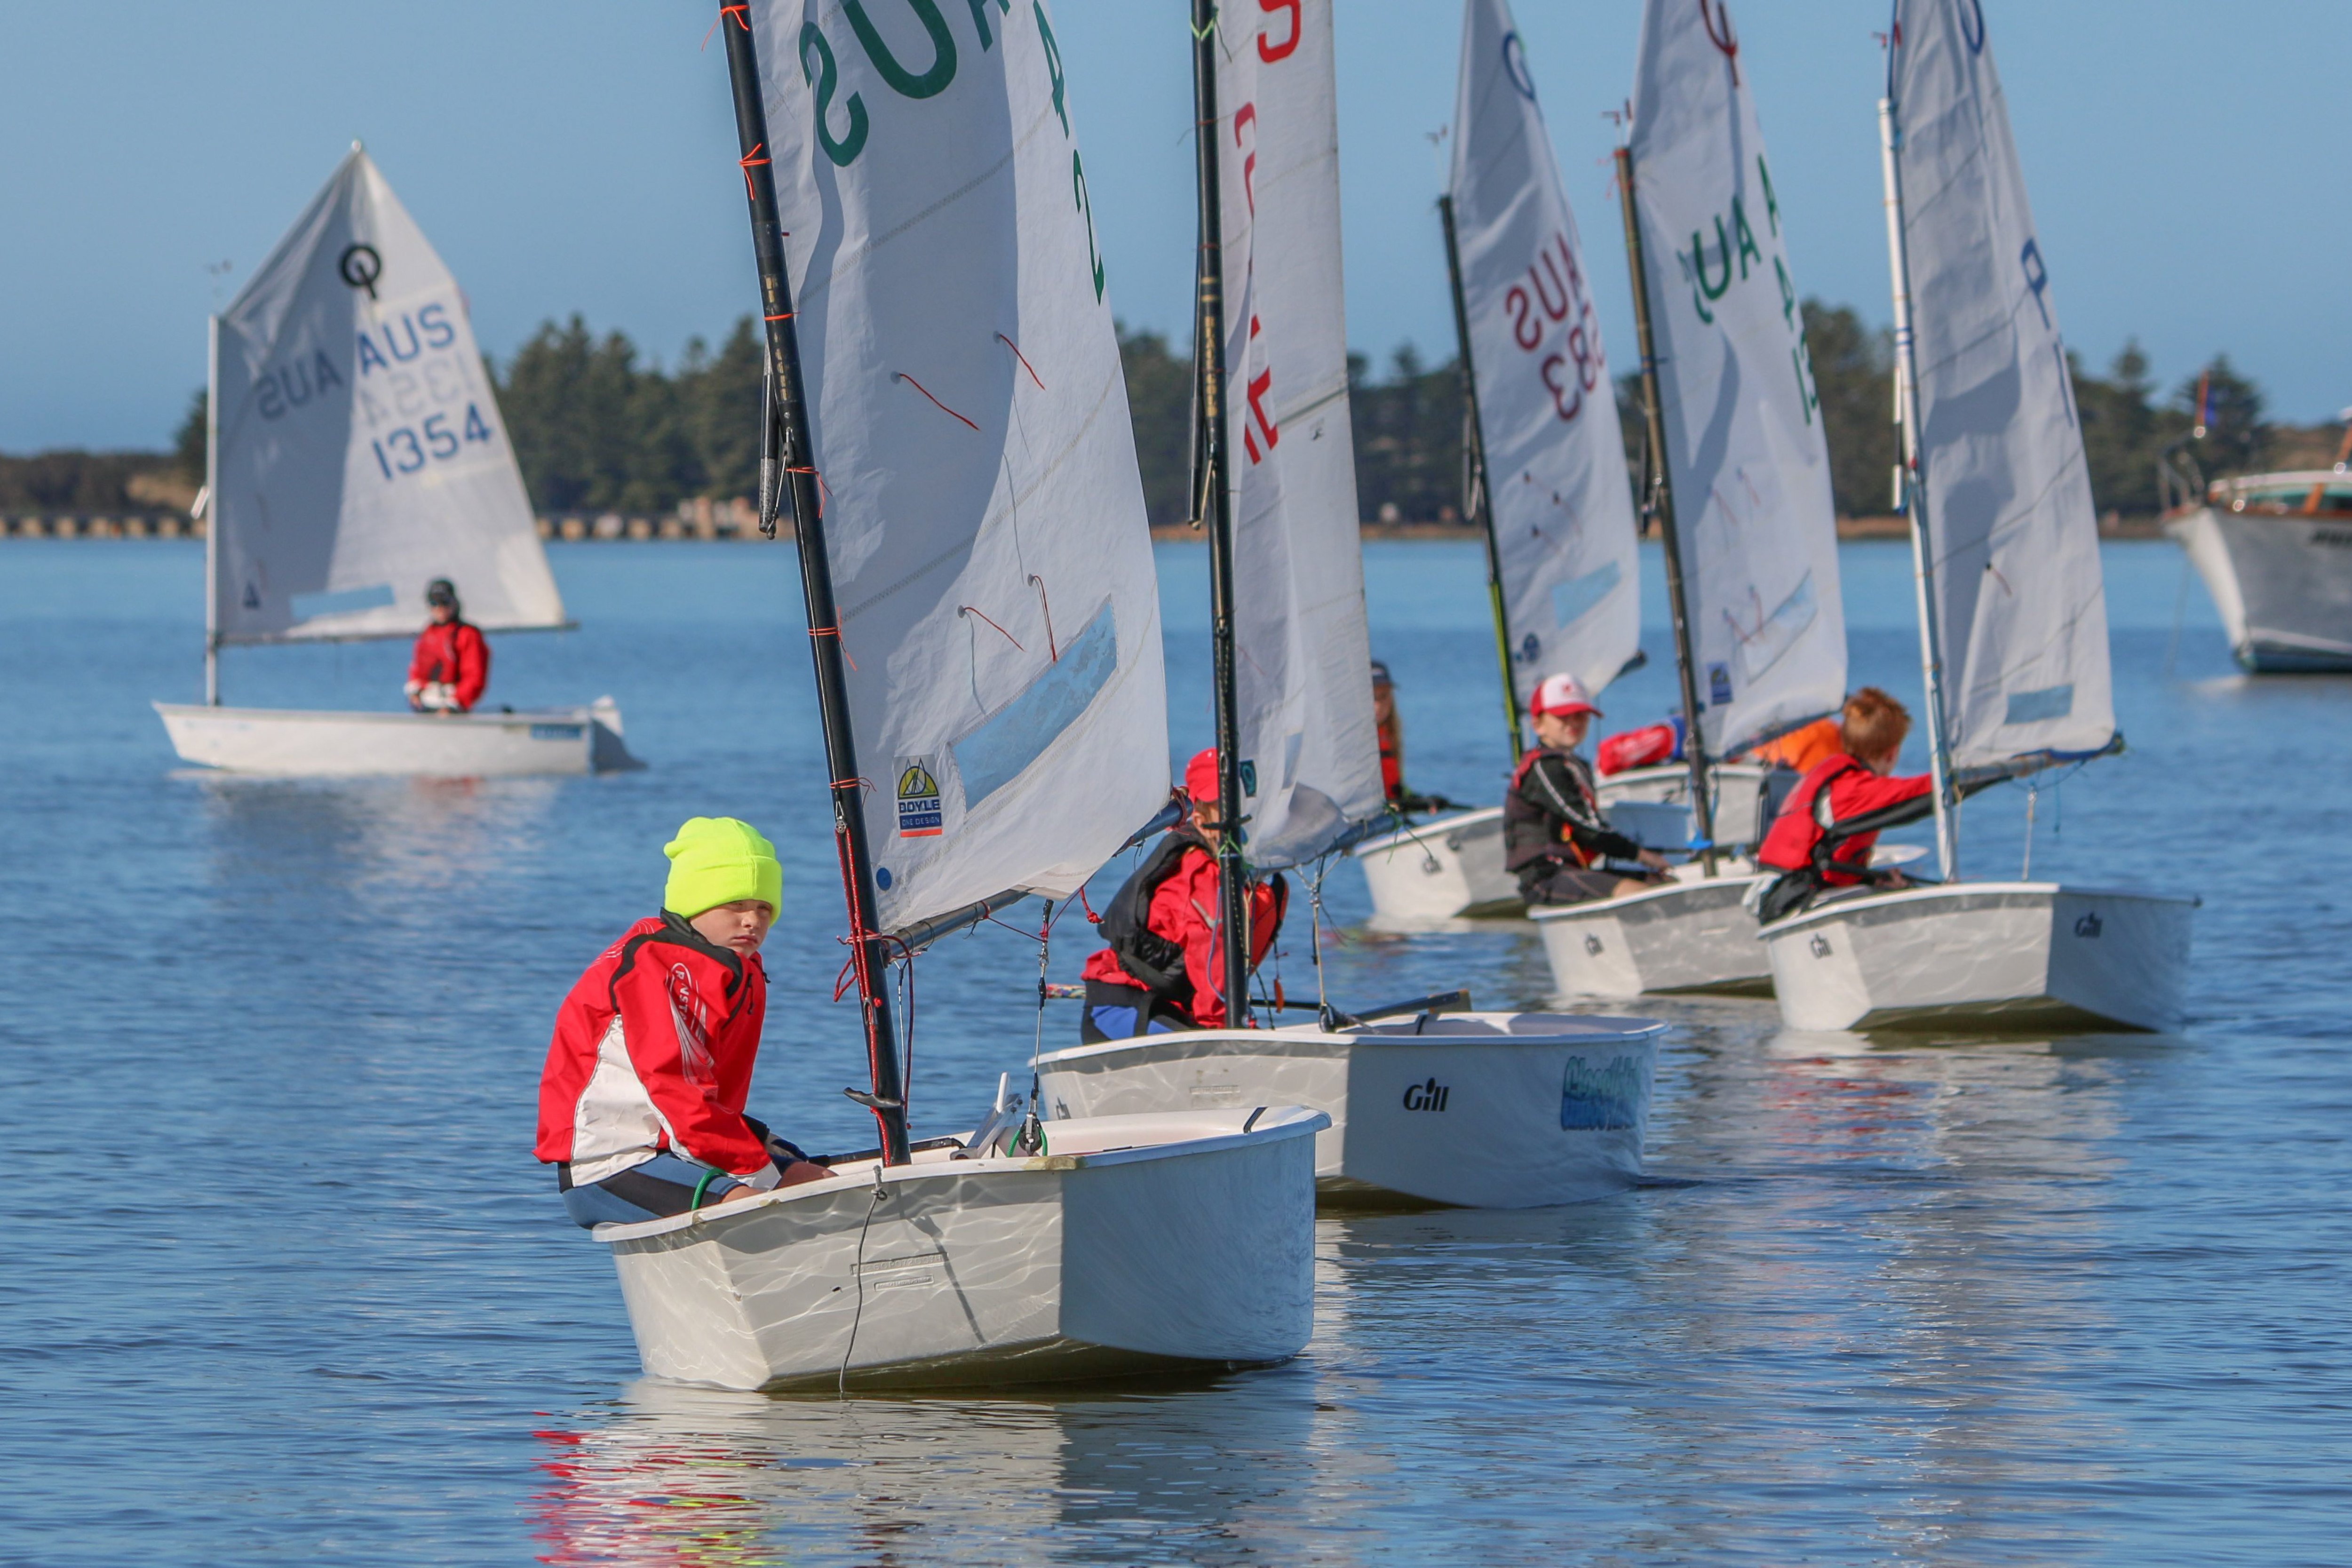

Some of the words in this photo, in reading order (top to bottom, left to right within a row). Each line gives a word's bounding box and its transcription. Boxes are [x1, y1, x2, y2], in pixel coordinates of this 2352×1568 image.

[358, 303, 455, 376] AUS
[371, 401, 492, 480] 1354
[898, 799, 940, 813] DOYLE
[1403, 1077, 1450, 1112] Gill
